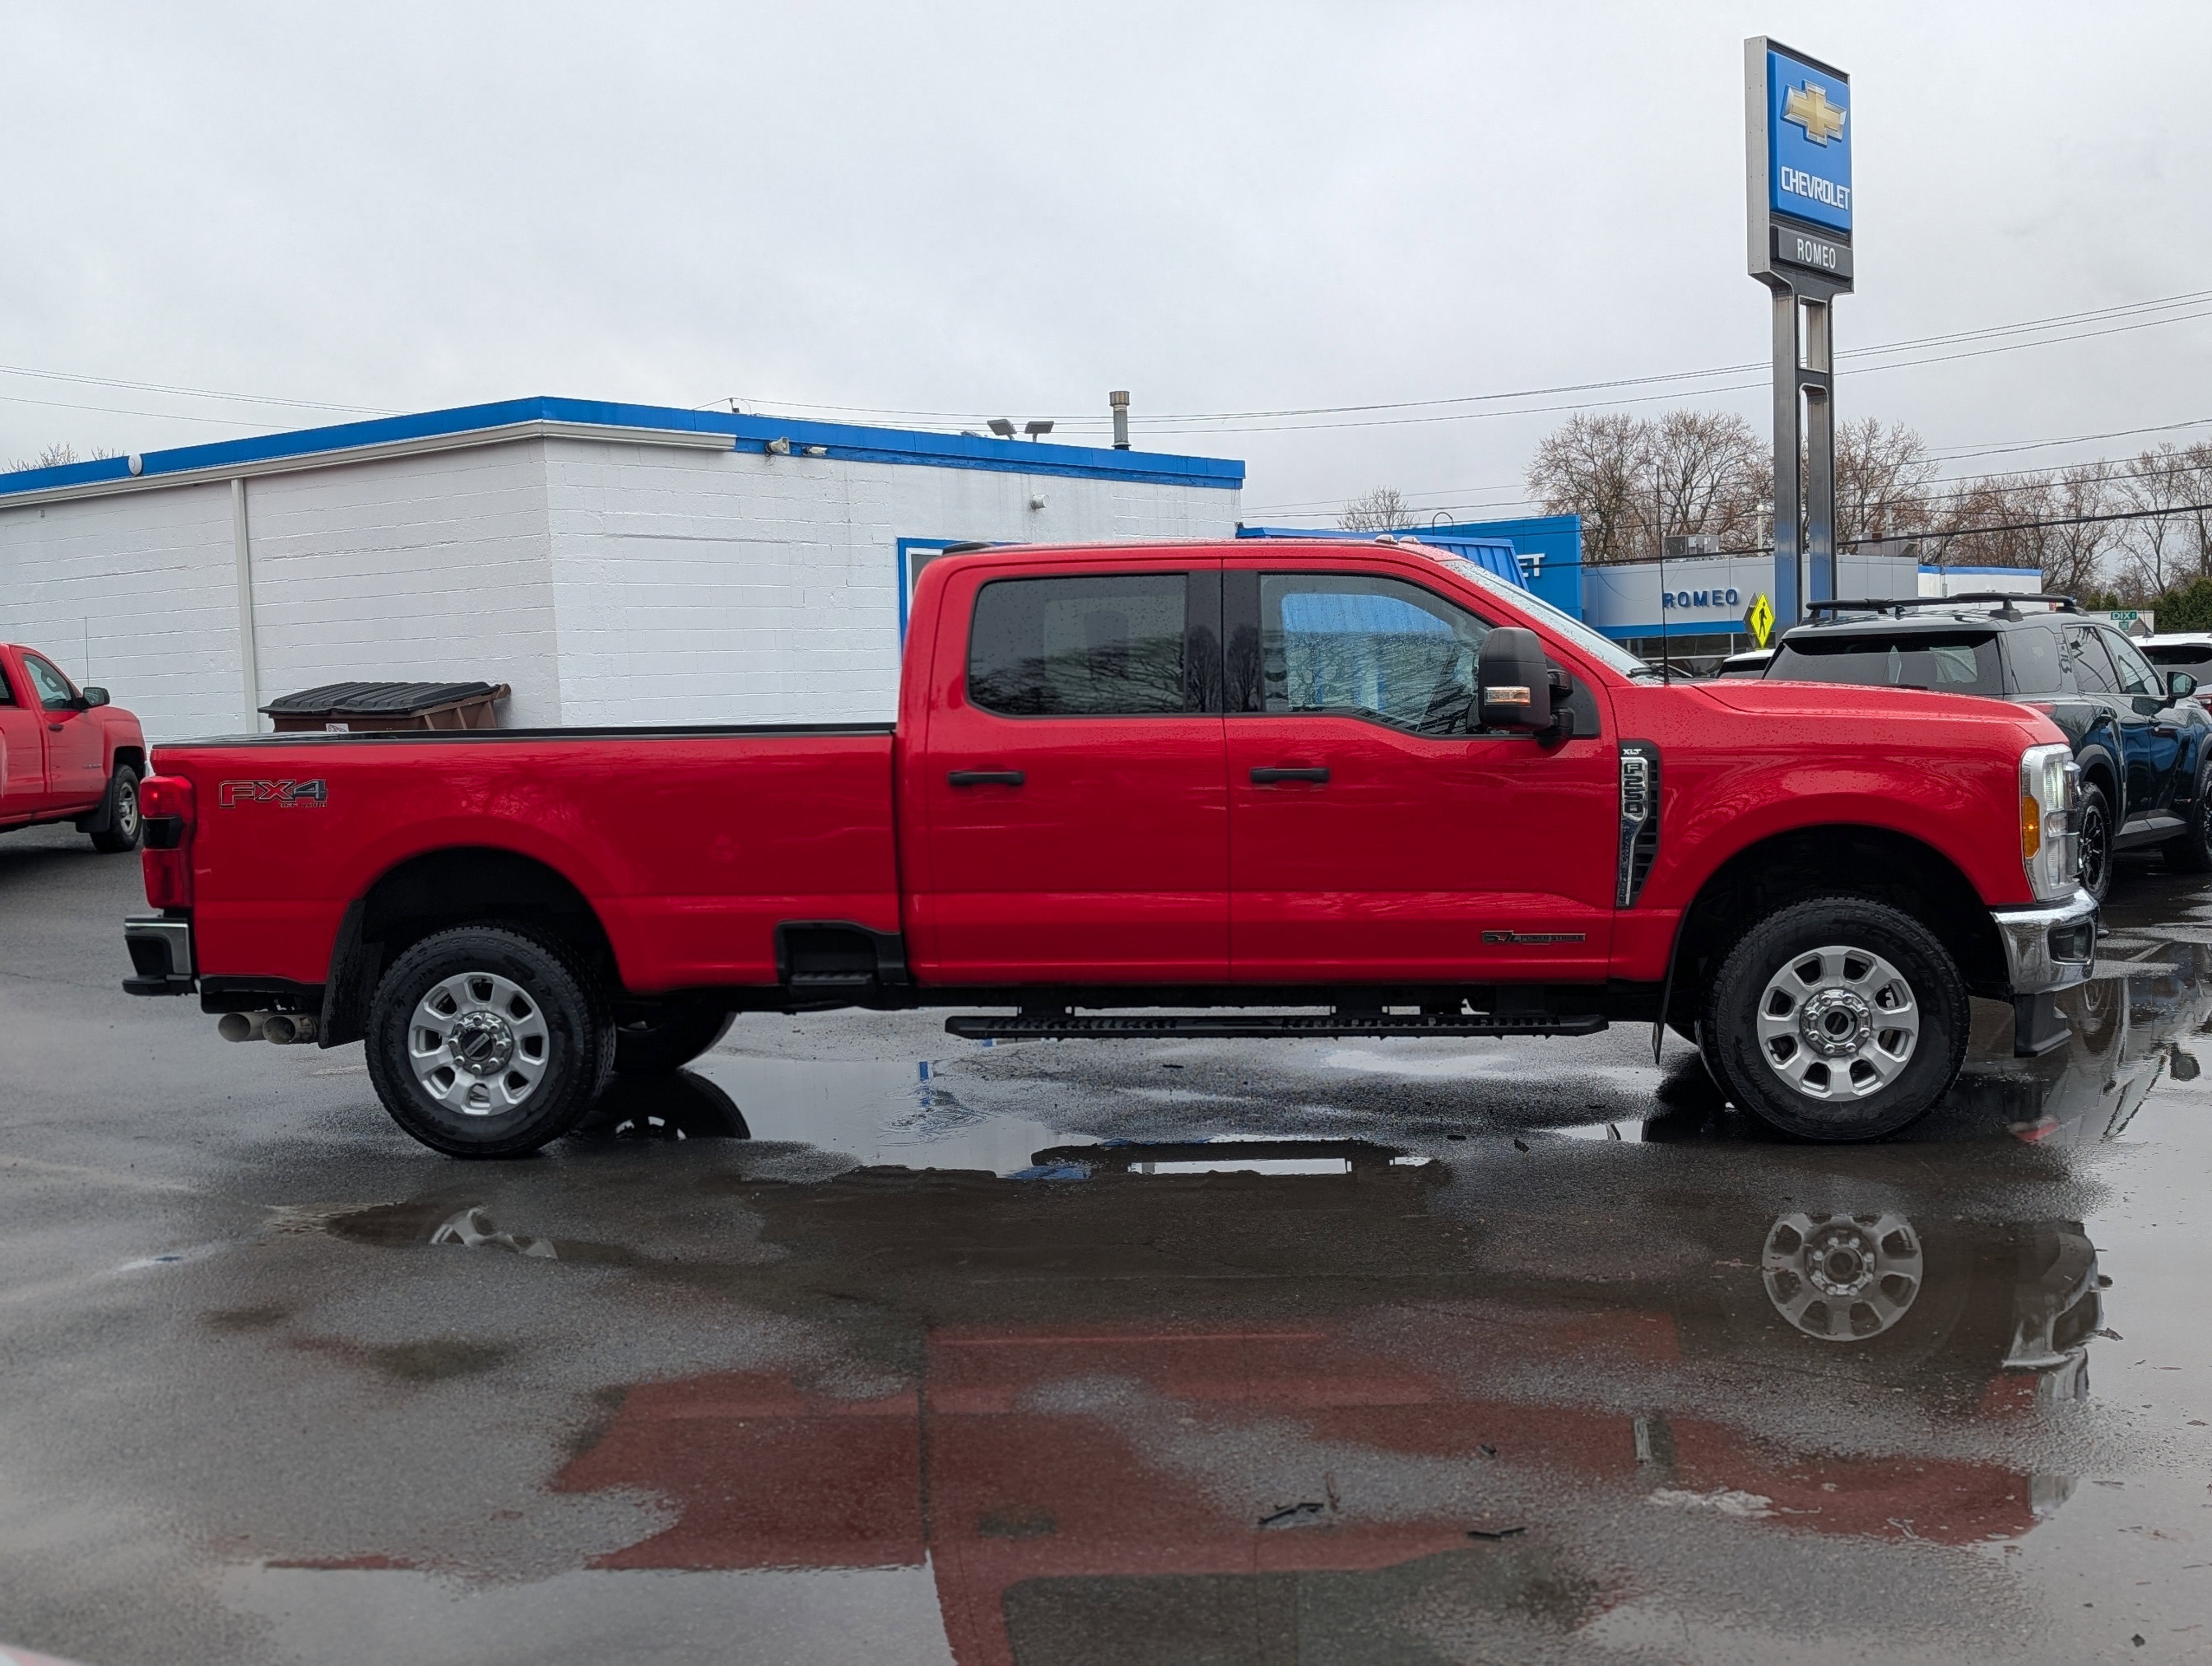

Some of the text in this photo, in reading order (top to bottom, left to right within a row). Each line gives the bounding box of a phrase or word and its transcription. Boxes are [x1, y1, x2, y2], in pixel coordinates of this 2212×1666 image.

[1780, 166, 1850, 211] CHEVROLET
[1797, 238, 1837, 270] ROMEO
[1662, 588, 1739, 608] ROMEO
[219, 779, 327, 808] FX4
